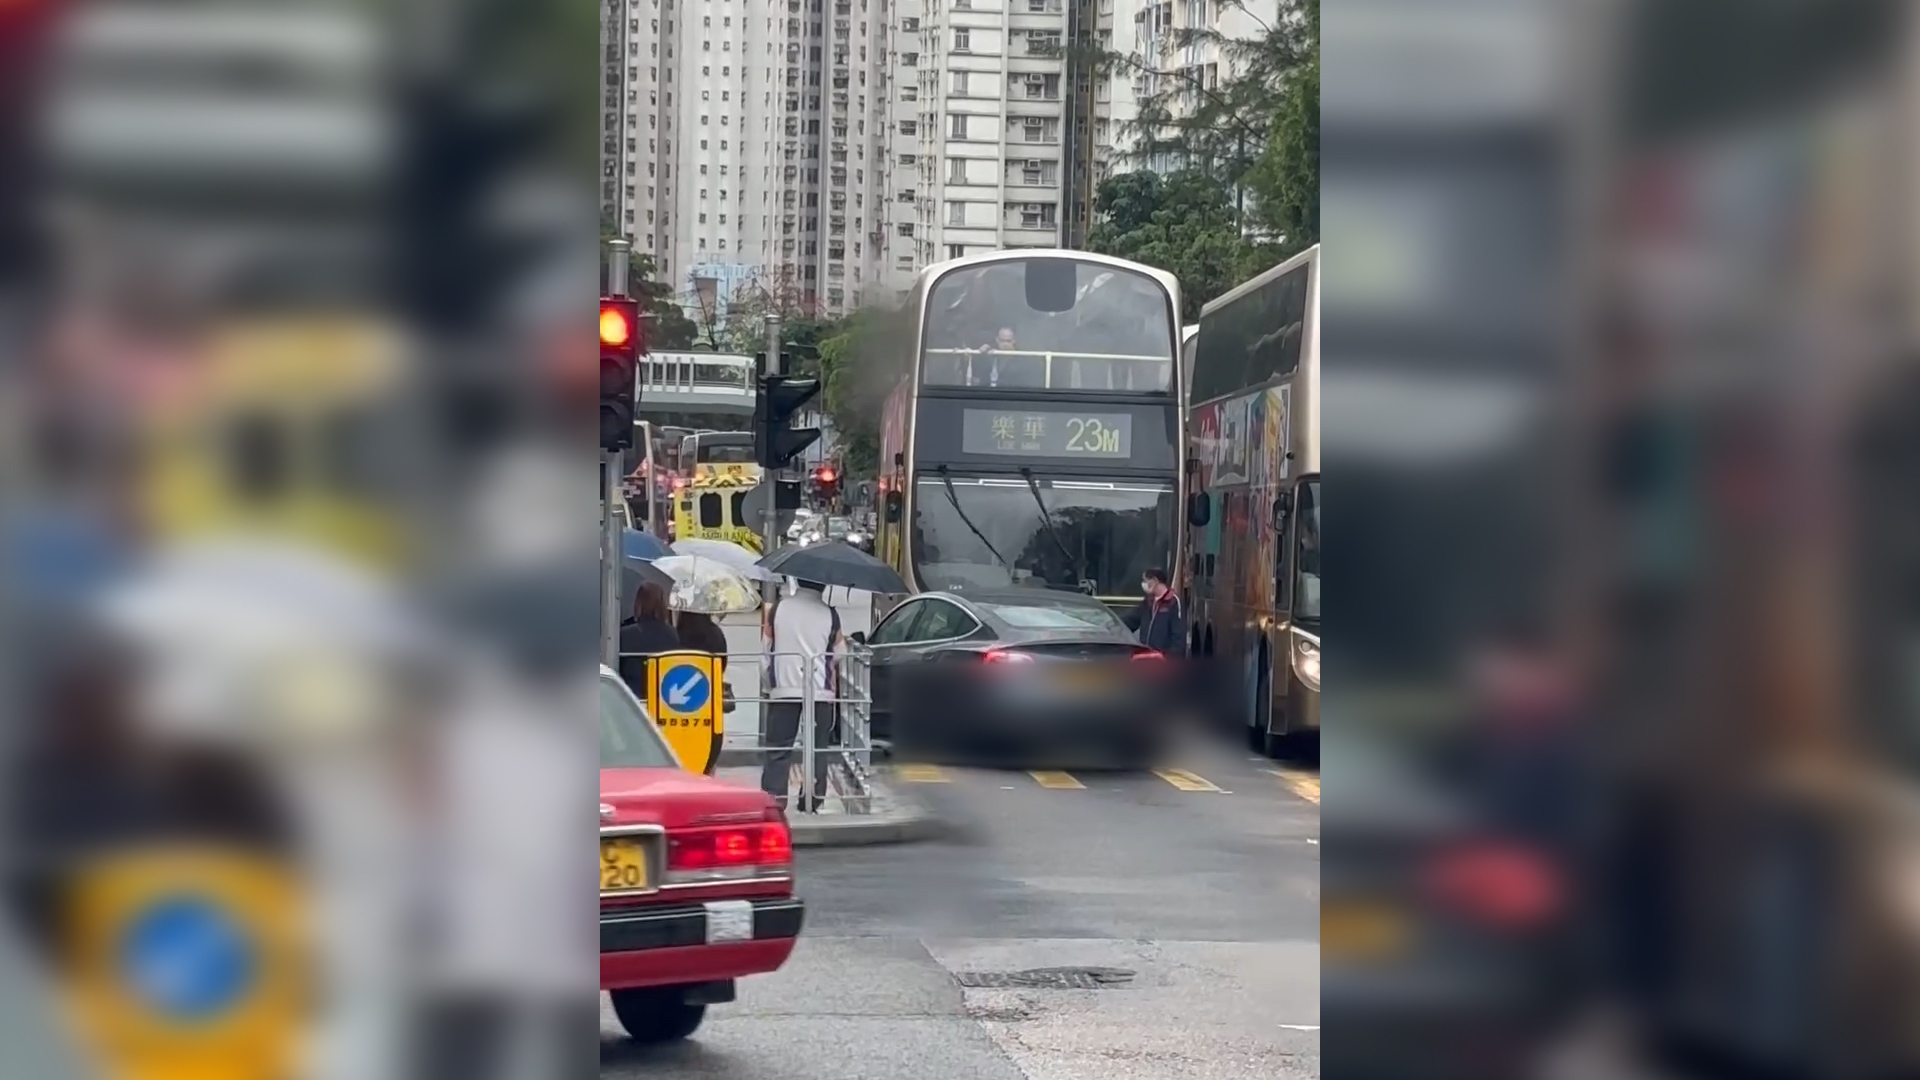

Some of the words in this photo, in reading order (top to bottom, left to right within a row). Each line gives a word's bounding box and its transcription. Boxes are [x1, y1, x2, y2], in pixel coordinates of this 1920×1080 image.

[991, 416, 1046, 439] 樂華
[1065, 418, 1120, 452] 23M
[600, 864, 640, 887] 20
